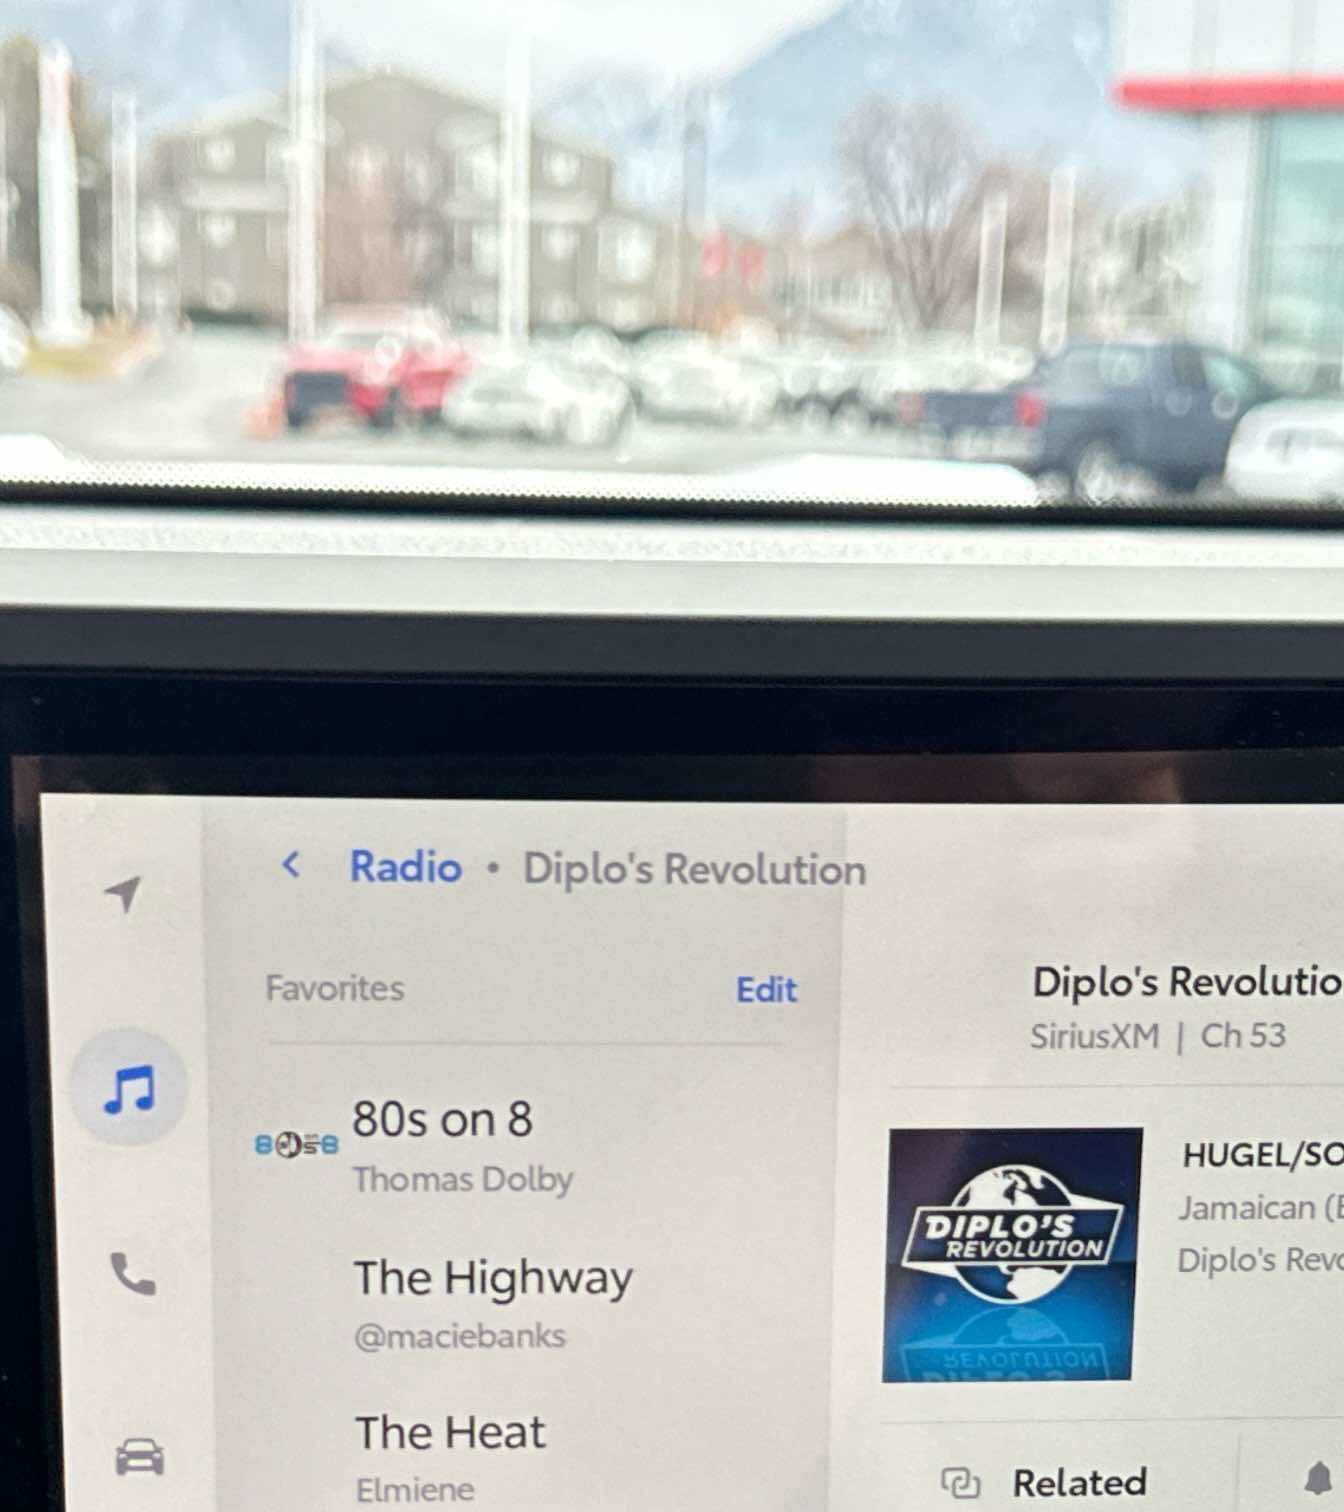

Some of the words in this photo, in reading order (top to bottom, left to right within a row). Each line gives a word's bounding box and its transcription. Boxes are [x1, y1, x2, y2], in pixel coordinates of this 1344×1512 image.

[351, 849, 462, 883] Radio
[524, 852, 653, 893] Diplo's
[666, 852, 866, 886] Revolution
[266, 974, 405, 1002] Favorites
[737, 976, 797, 1003] Edit
[1034, 965, 1158, 1005] Diplo's
[1031, 1022, 1159, 1050] SiriusXM
[1201, 1022, 1241, 1048] Ch
[1250, 1022, 1286, 1048] 53
[353, 1100, 428, 1137] 80s
[441, 1109, 495, 1137] on
[509, 1100, 532, 1137] 8
[353, 1166, 474, 1193] Thomas
[484, 1165, 574, 1198] Dolby
[1178, 1195, 1315, 1221] Jamaican
[946, 1240, 1103, 1258] REVOLUTION
[1178, 1247, 1275, 1279] Diplo's
[355, 1259, 431, 1295] The
[446, 1258, 633, 1304] Highway
[355, 1322, 566, 1352] @maciebanks
[356, 1415, 432, 1450] The
[446, 1415, 546, 1450] Heat
[357, 1477, 475, 1502] Elmiene
[1012, 1465, 1147, 1498] Related
